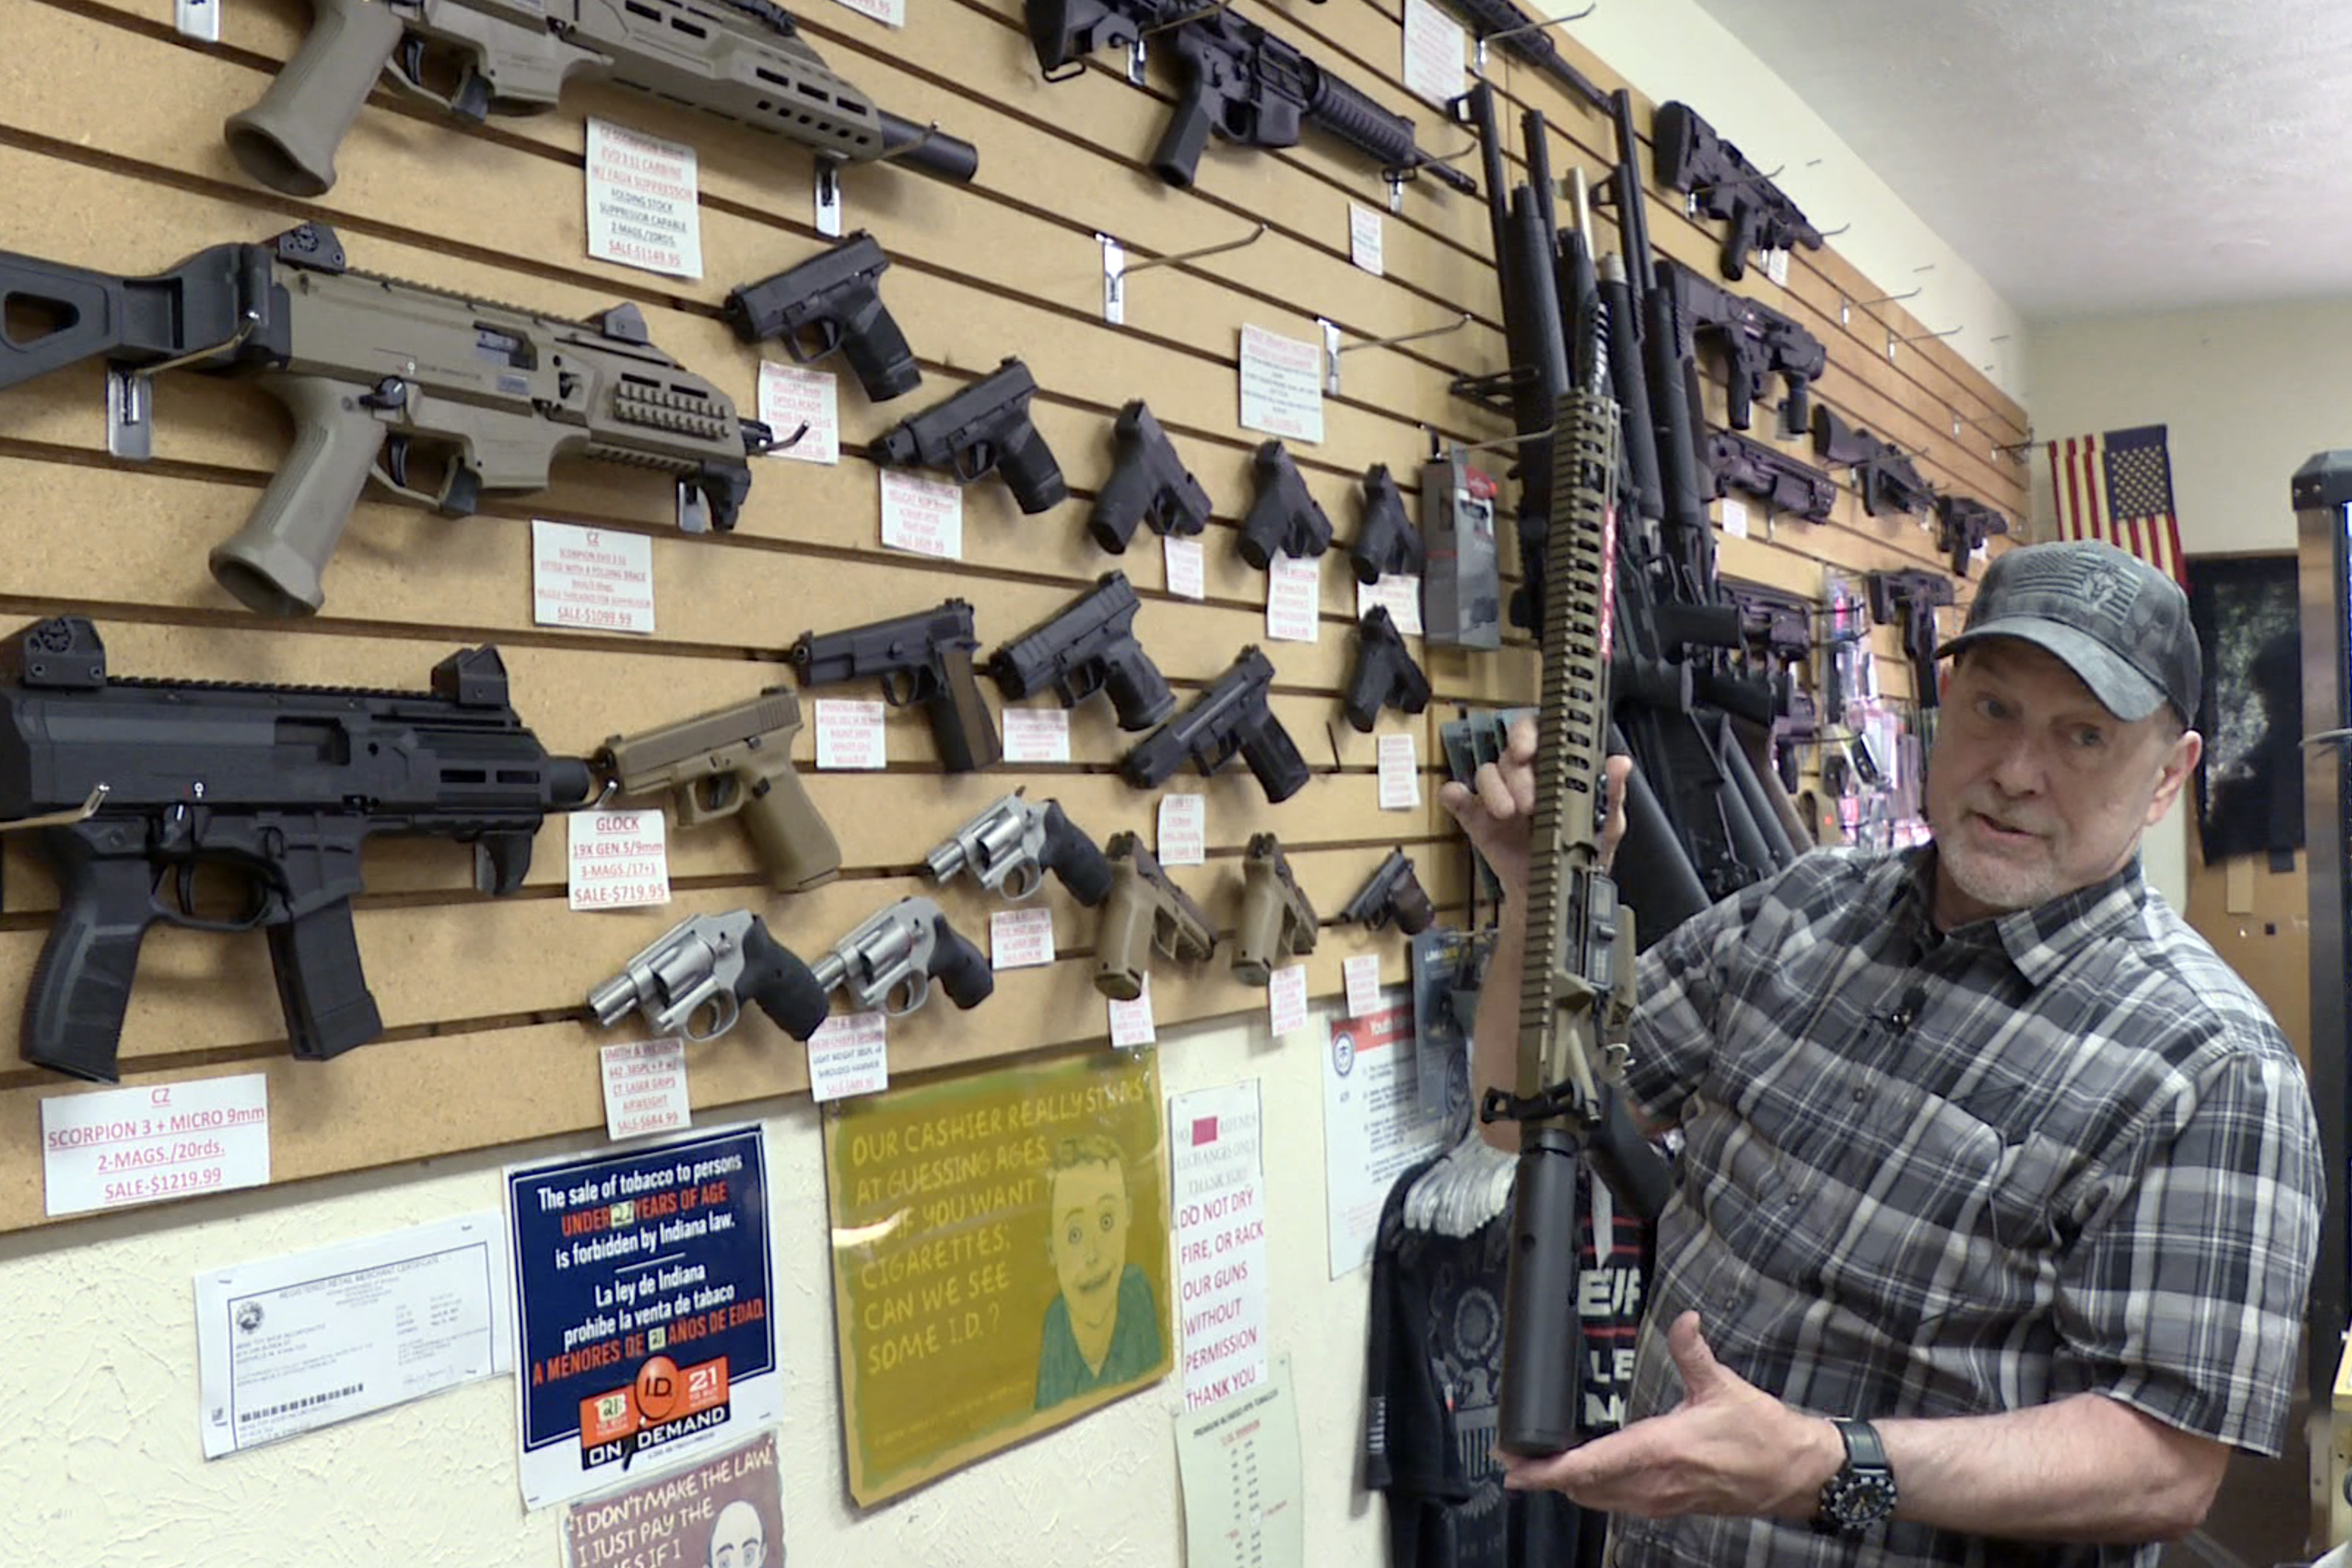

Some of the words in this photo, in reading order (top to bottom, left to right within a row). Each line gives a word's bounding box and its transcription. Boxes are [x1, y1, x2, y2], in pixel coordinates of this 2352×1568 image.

[596, 816, 639, 832] GLOCK
[574, 843, 593, 857] 19X
[575, 884, 665, 904] SALE-$719.95
[151, 1088, 170, 1104] CZ
[48, 1122, 137, 1147] SCORPION
[142, 1119, 151, 1135] 3
[170, 1110, 223, 1131] MICRO
[227, 1107, 265, 1123] 9mm
[852, 1128, 899, 1168] OUR
[904, 1107, 1003, 1153] CASHIER
[1007, 1092, 1082, 1132] REALLY
[98, 1139, 226, 1172] 2-MAGS./20rds.
[856, 1177, 882, 1208] AT
[887, 1147, 991, 1200] GUESSING
[105, 1167, 222, 1201] SALE-$1219.99
[537, 1187, 565, 1211] The
[568, 1180, 598, 1205] sale
[601, 1174, 617, 1198] of
[620, 1167, 674, 1193] tobacco
[676, 1164, 691, 1183] to
[694, 1154, 743, 1184] persons
[562, 1208, 611, 1238] UNDER
[634, 1193, 678, 1219] YEARS
[680, 1189, 697, 1209] OF
[701, 1180, 727, 1204] AGE
[922, 1194, 966, 1236] YOU
[970, 1178, 1035, 1218] WANT
[1180, 1205, 1199, 1228] DO
[1203, 1196, 1228, 1222] NOT
[1231, 1187, 1253, 1212] DRY
[555, 1248, 570, 1269] is
[573, 1233, 639, 1266] forbidden
[640, 1227, 658, 1253] by
[660, 1219, 707, 1244] Indiana
[709, 1211, 736, 1230] law.
[1181, 1239, 1212, 1265] FIRE,
[1215, 1231, 1232, 1253] OR
[1235, 1219, 1263, 1245] RACK
[595, 1285, 612, 1307] La
[615, 1279, 635, 1306] ley
[639, 1274, 656, 1294] de
[658, 1263, 705, 1290] Indiana
[863, 1289, 914, 1332] CAN
[921, 1275, 962, 1313] WE
[968, 1260, 1010, 1299] SEE
[1183, 1274, 1211, 1301] OUR
[1214, 1260, 1248, 1289] GUNS
[564, 1315, 616, 1351] prohibe
[619, 1309, 633, 1330] la
[635, 1303, 672, 1326] venta
[675, 1294, 691, 1315] de
[694, 1284, 735, 1309] tabaco
[1185, 1297, 1242, 1337] WITHOUT
[532, 1361, 544, 1387] A
[546, 1339, 621, 1382] MENORES
[625, 1334, 645, 1357] DE
[667, 1315, 707, 1346] AÑOS
[710, 1310, 726, 1328] DE
[868, 1323, 942, 1376] SOME
[1186, 1325, 1257, 1374] PERMISSION
[689, 1365, 718, 1393] 21
[1186, 1376, 1230, 1412] THANK
[1232, 1364, 1256, 1391] YOU
[589, 1440, 623, 1466] ON
[637, 1407, 726, 1450] DEMAND
[587, 1495, 642, 1535] DON'T
[643, 1474, 699, 1513] MAKE
[701, 1460, 733, 1486] THE
[578, 1545, 587, 1568] I
[592, 1528, 636, 1564] JUST
[640, 1513, 675, 1544] PAY
[680, 1496, 714, 1529] THE
[672, 1538, 681, 1559] I
